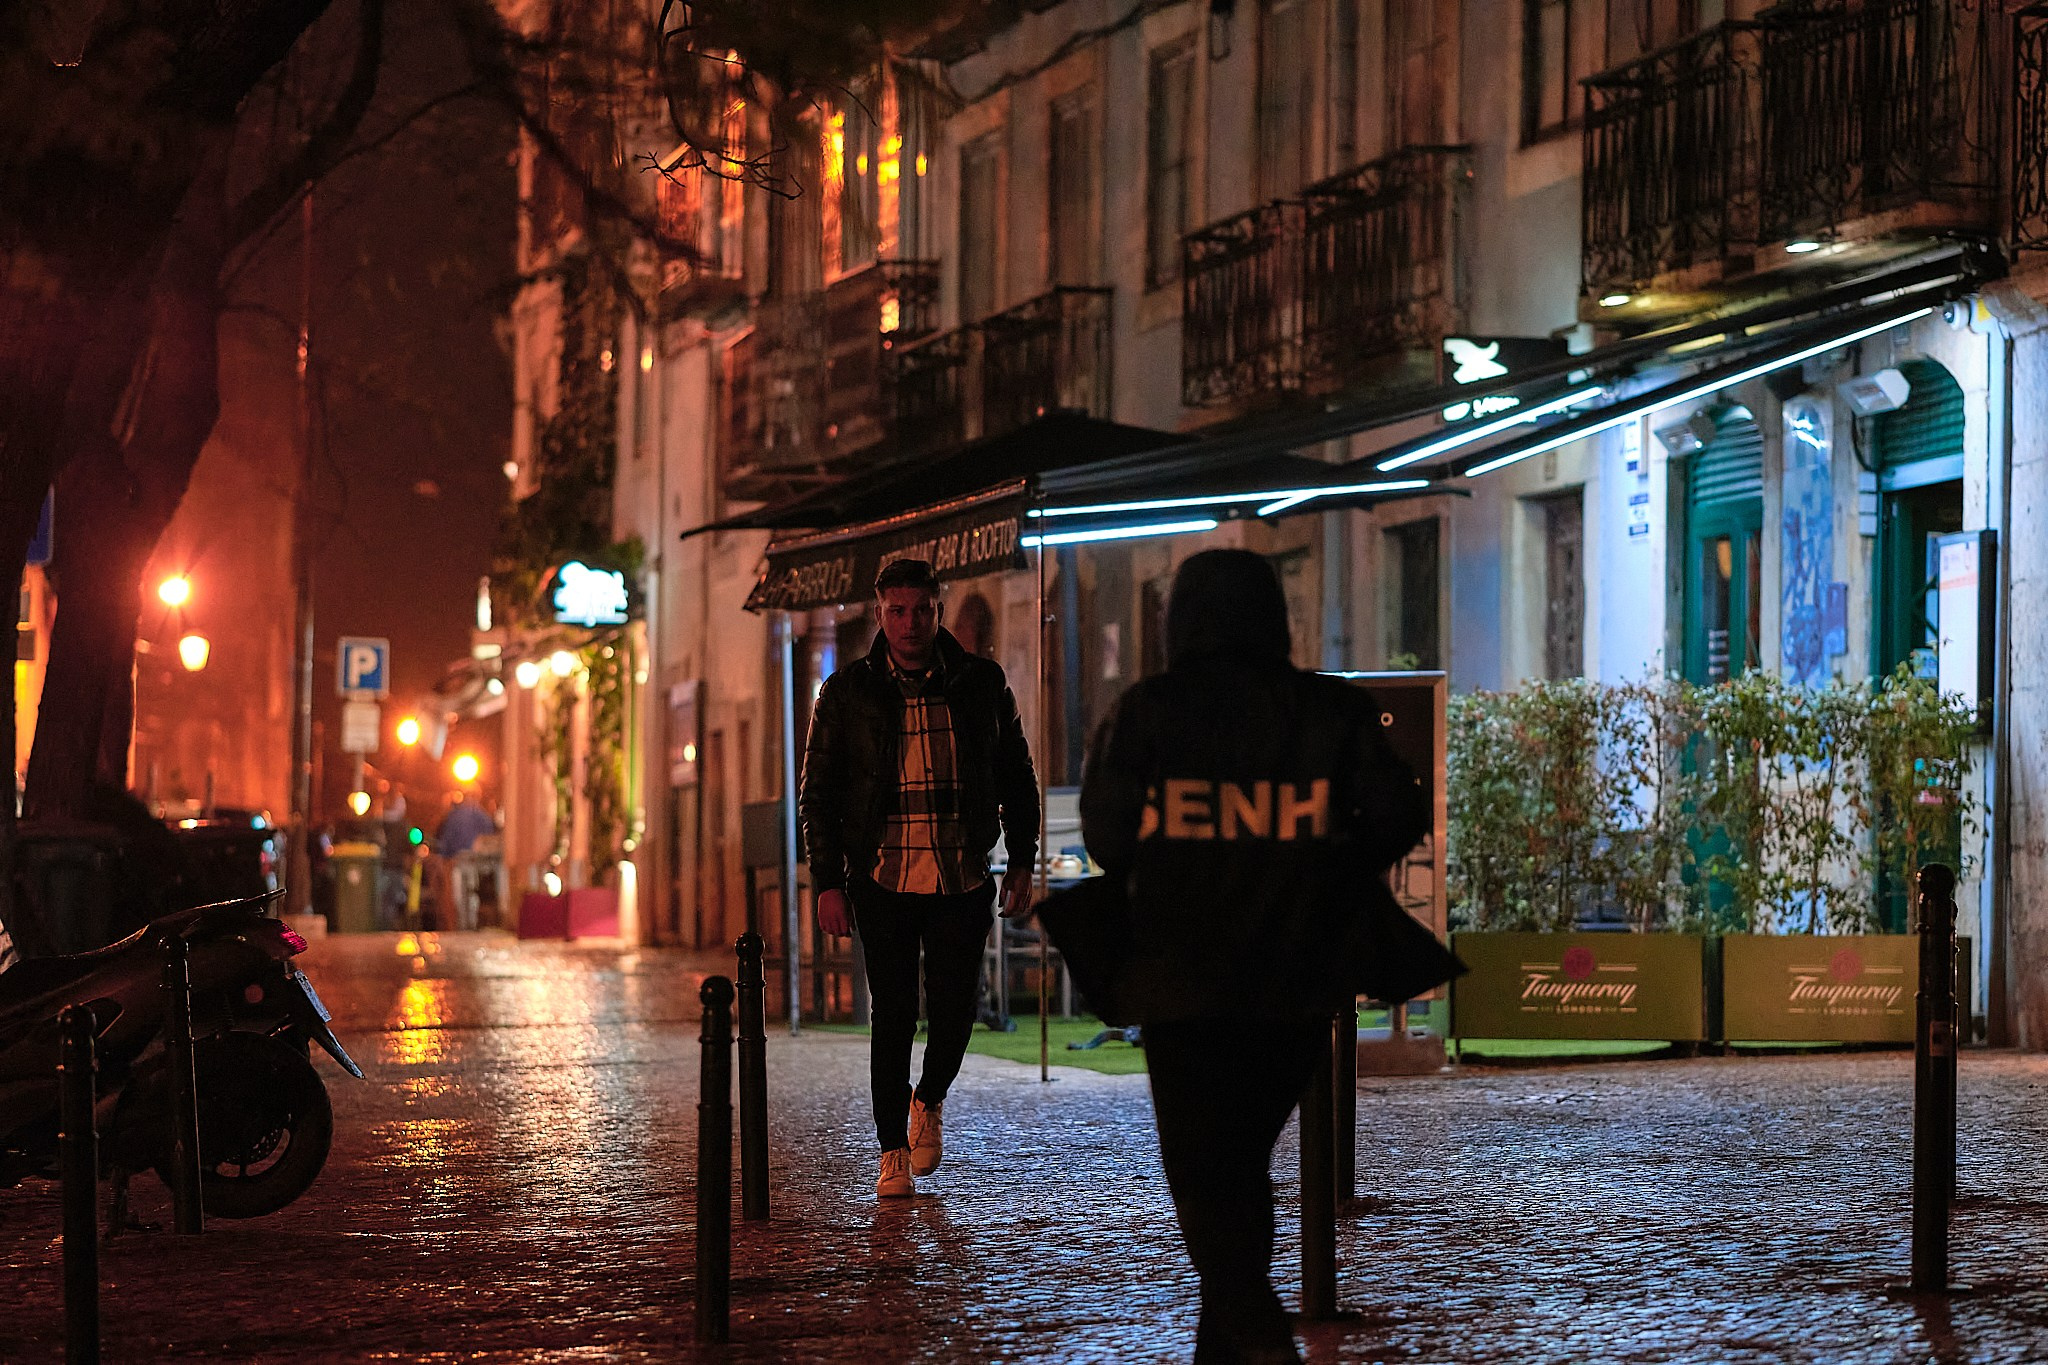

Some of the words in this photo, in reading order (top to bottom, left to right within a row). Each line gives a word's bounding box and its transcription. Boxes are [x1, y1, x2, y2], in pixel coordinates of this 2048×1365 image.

[348, 645, 379, 689] P
[1520, 973, 1638, 1005] Tanqueray
[1789, 976, 1904, 1007] Tanqueray
